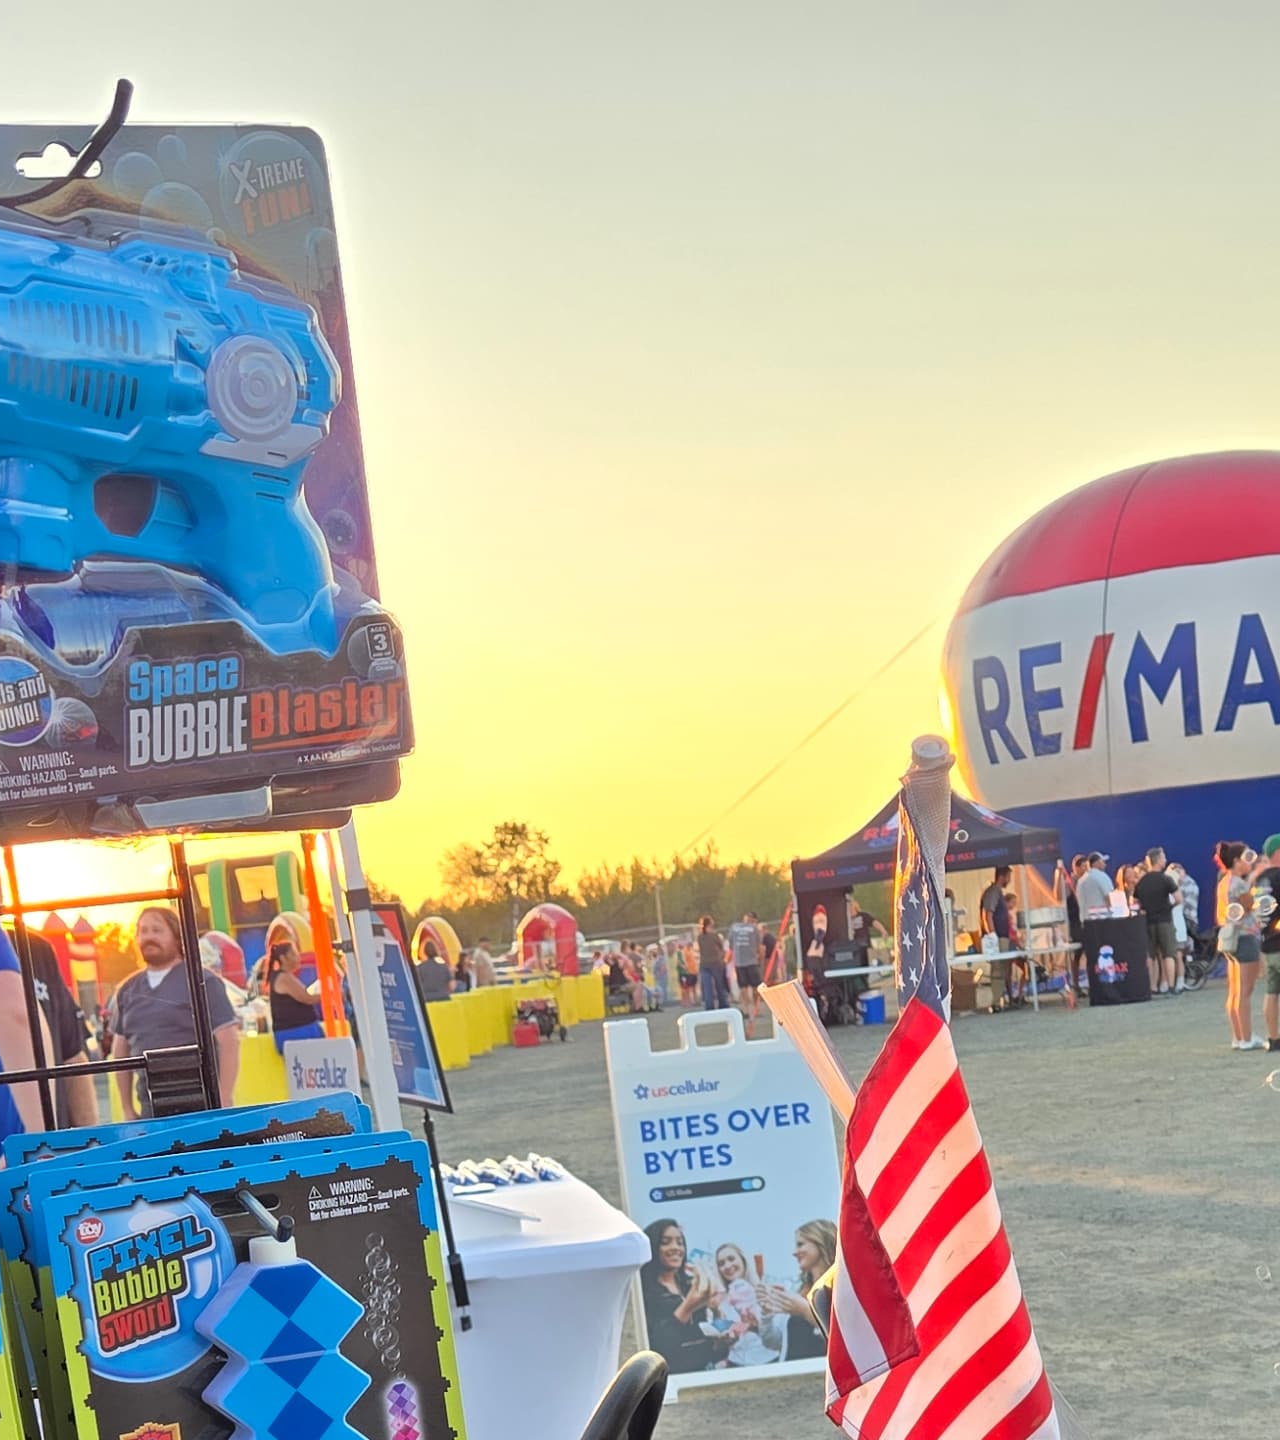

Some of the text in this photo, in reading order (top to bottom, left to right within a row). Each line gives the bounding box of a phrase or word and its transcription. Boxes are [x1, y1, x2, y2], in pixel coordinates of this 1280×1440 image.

[374, 634, 387, 651] 3
[18, 673, 46, 699] and
[129, 657, 239, 705] Space
[129, 680, 405, 766] BUBBLE Blaster
[19, 752, 75, 771] WARNING:
[640, 1102, 810, 1142] BITES OVER
[644, 1144, 733, 1174] BYTES
[89, 1218, 207, 1280] PIXEL
[94, 1259, 182, 1317] Bubble
